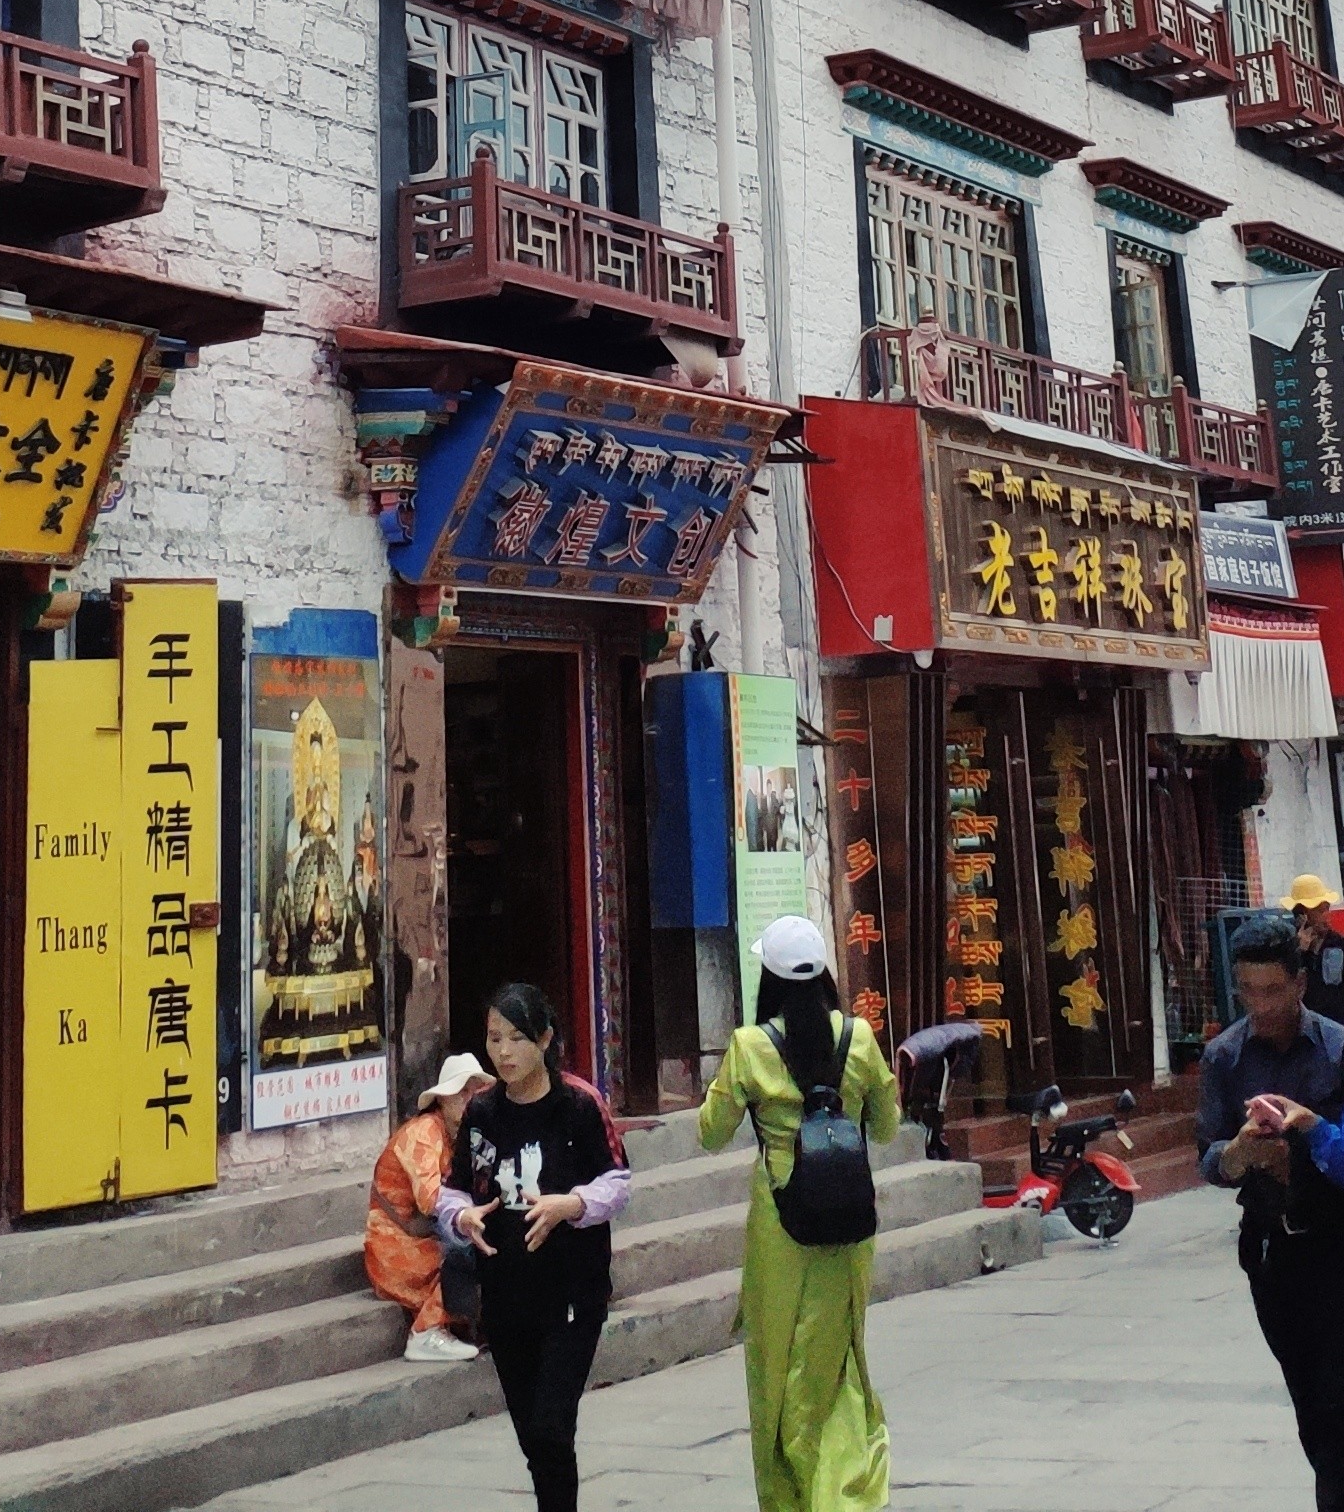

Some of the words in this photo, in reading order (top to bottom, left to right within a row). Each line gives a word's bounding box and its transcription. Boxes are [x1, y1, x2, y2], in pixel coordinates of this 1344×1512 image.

[34, 824, 113, 860] Family
[145, 633, 194, 1150] 手工精品唐卡
[37, 915, 109, 954] Thang
[58, 1008, 88, 1046] Ka
